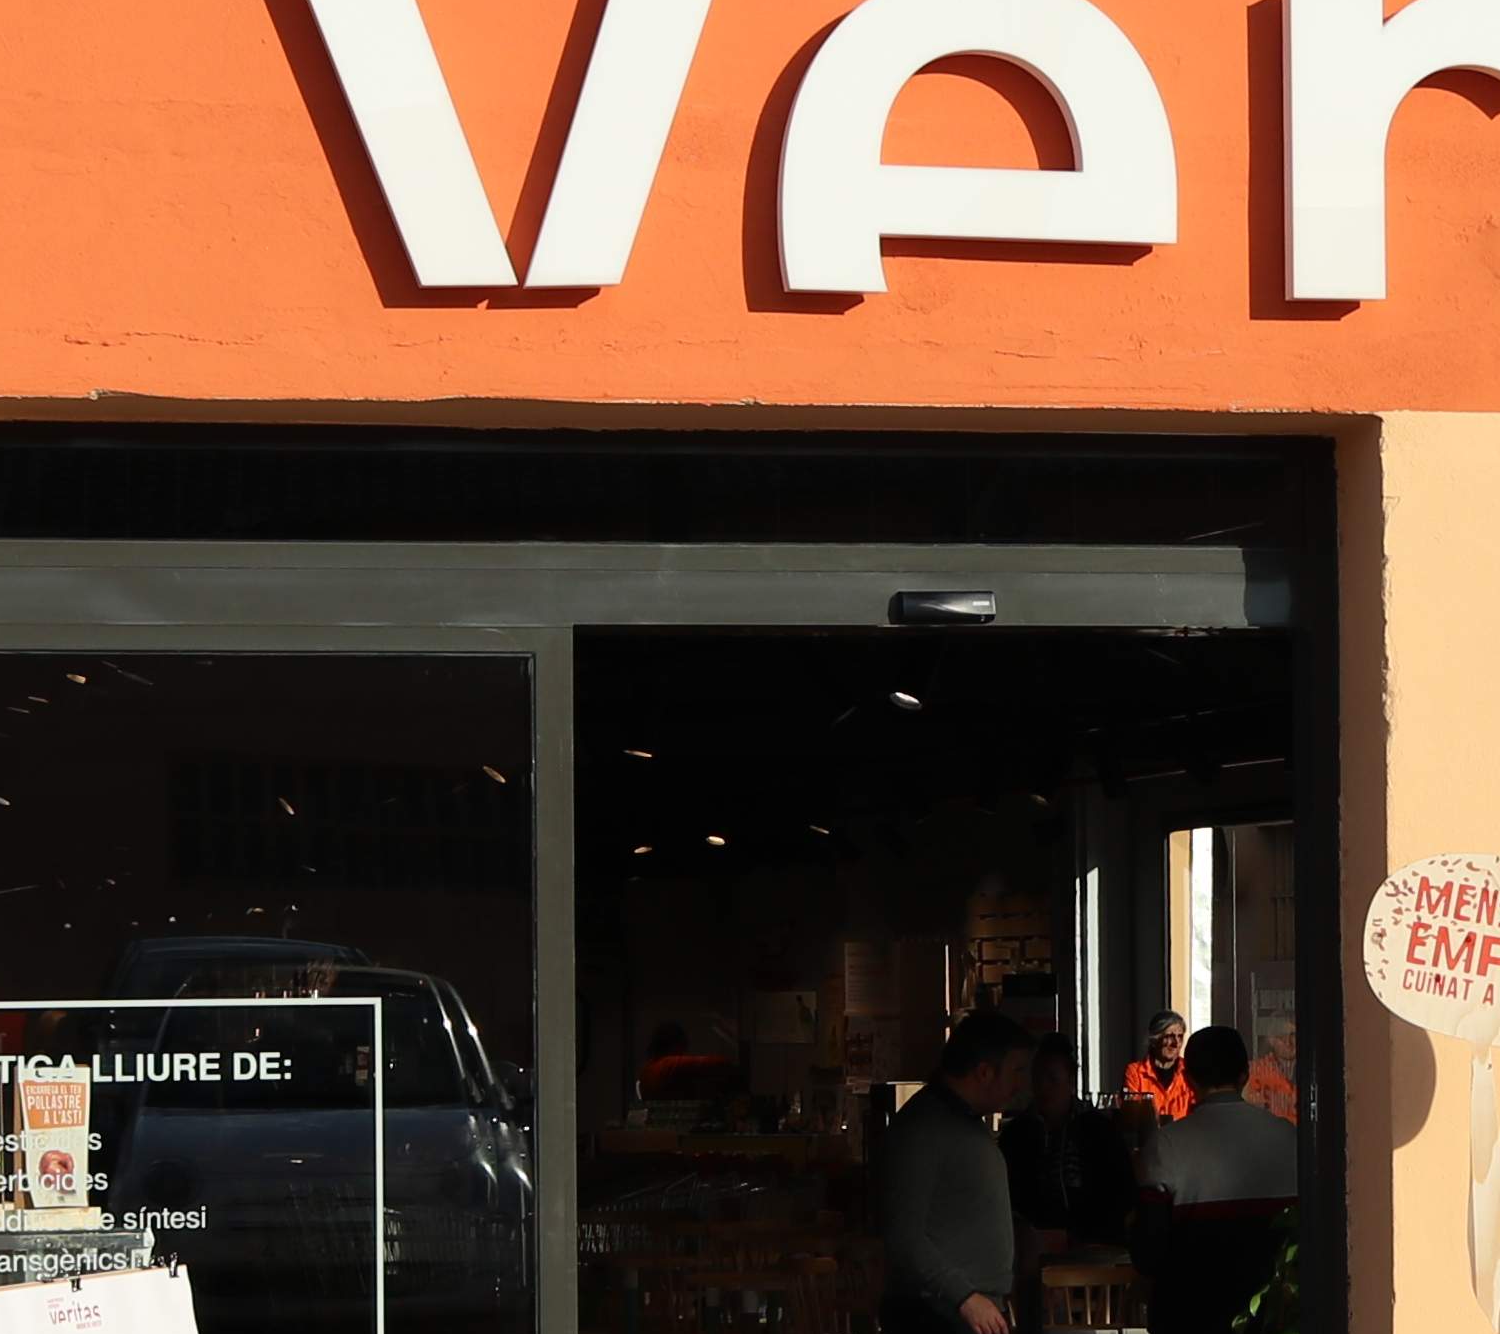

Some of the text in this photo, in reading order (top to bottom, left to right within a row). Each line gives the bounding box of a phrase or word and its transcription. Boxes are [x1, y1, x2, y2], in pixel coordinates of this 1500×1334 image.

[1482, 983, 1494, 1006] A
[92, 1052, 221, 1083] LLIURE
[232, 1051, 293, 1082] DE:
[27, 1094, 82, 1111] POLLASTRE
[124, 1205, 207, 1230] síntesi
[49, 1302, 101, 1326] veritas
